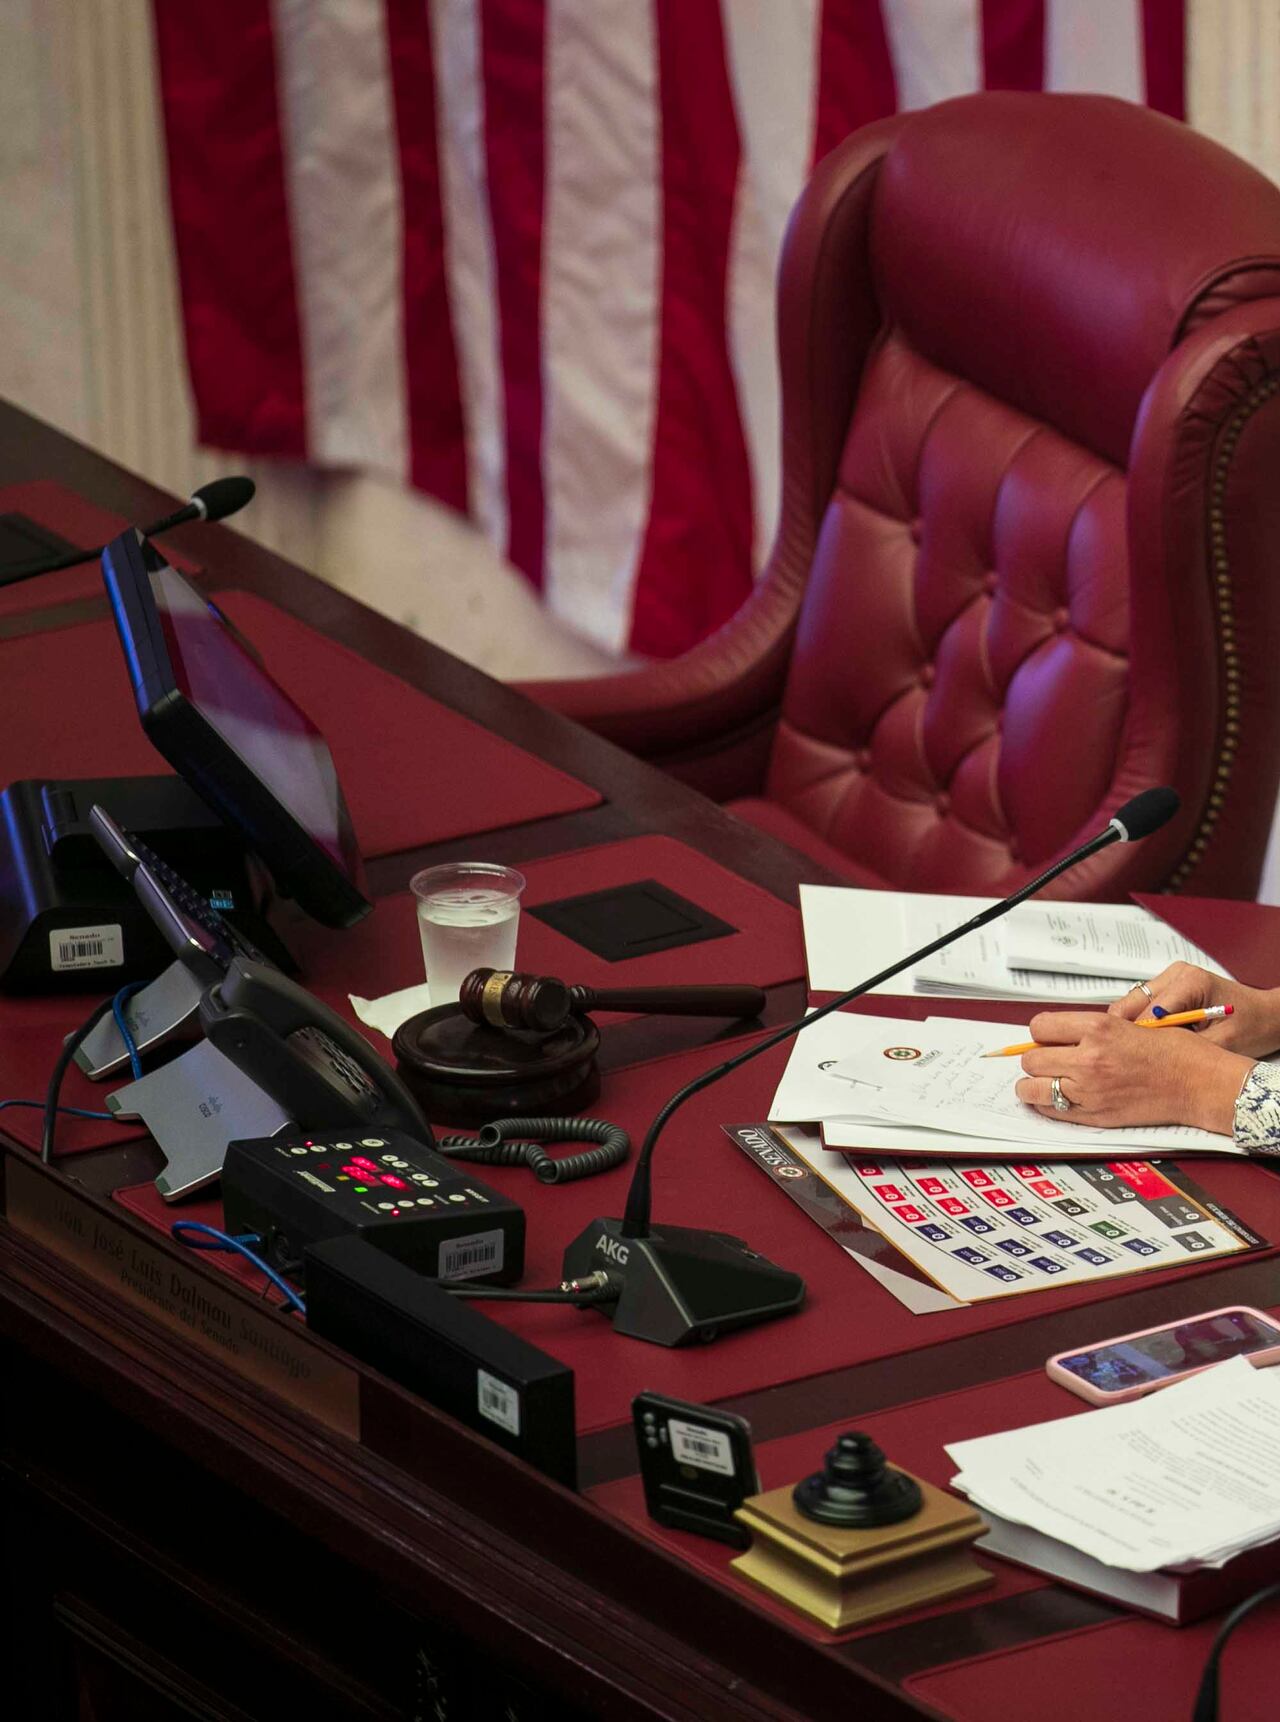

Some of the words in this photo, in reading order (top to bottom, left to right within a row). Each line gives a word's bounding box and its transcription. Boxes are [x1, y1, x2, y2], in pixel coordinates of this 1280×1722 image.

[737, 1129, 788, 1166] SENADO
[595, 1234, 630, 1265] AKG
[93, 1224, 125, 1263] José
[131, 1249, 163, 1289] Luis
[170, 1272, 232, 1331] Dalmau
[239, 1316, 313, 1380] Santiago
[120, 1269, 178, 1318] Presidente
[179, 1304, 197, 1333] del
[199, 1320, 241, 1355] Senado
